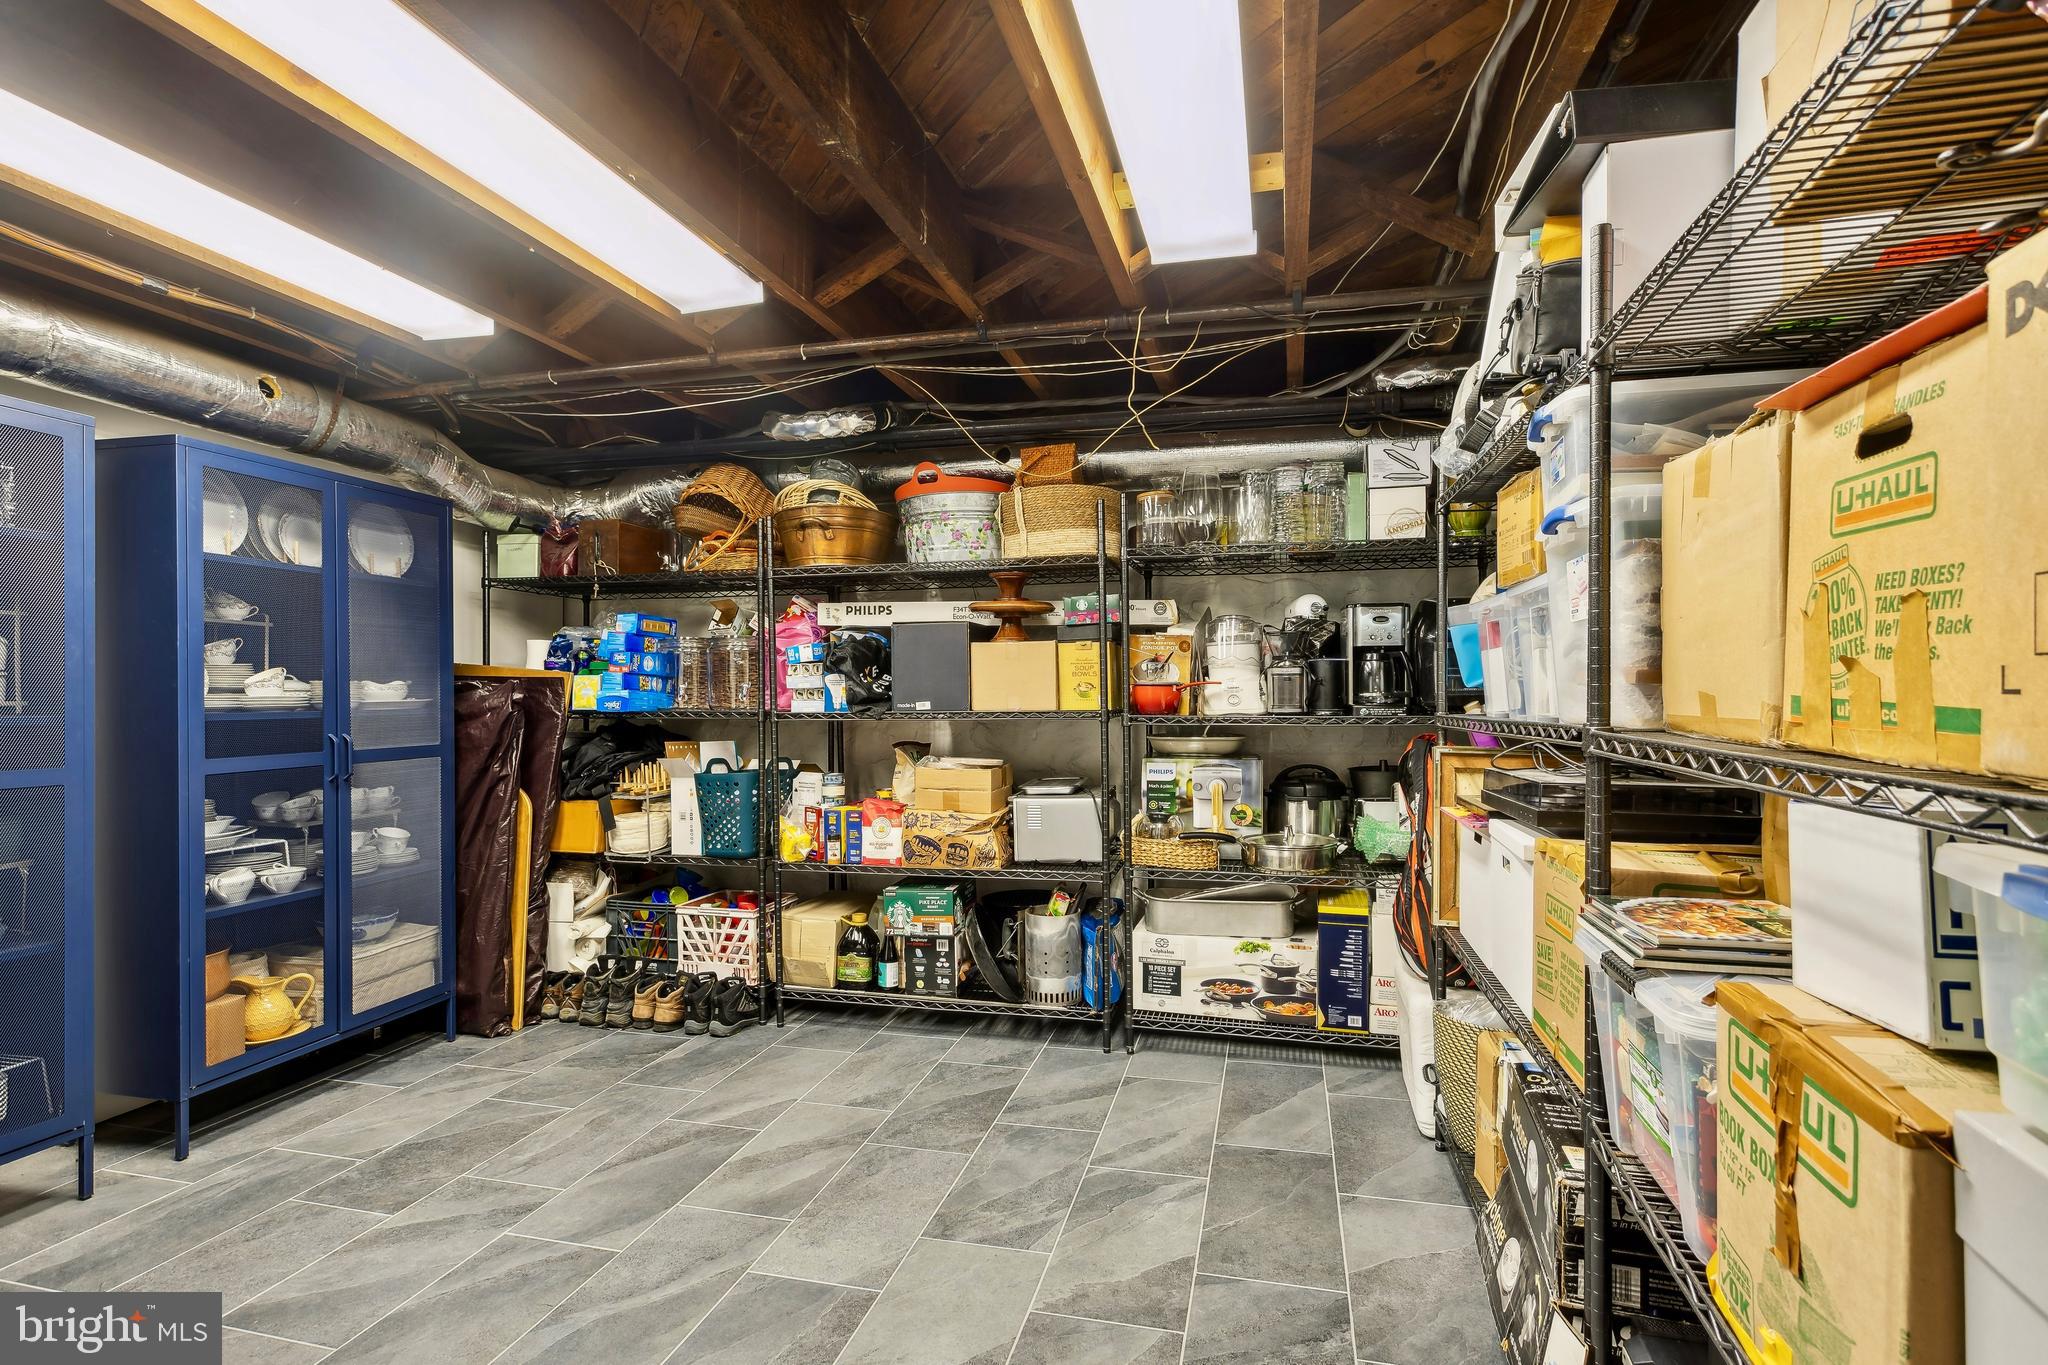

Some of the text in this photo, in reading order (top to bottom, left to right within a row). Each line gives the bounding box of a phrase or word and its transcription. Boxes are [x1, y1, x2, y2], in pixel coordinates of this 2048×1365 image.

[1874, 562, 1966, 591] NEED BOXES?
[845, 605, 893, 616] PHILIPS
[1926, 588, 1964, 612] ENTY!
[1874, 618, 1899, 637] We'l
[1935, 614, 1973, 635] Back
[1874, 643, 1893, 660] the
[1374, 1007, 1399, 1018] ARO
[1719, 1099, 1776, 1187] BOOK BOX
[1736, 1175, 1746, 1197] FT
